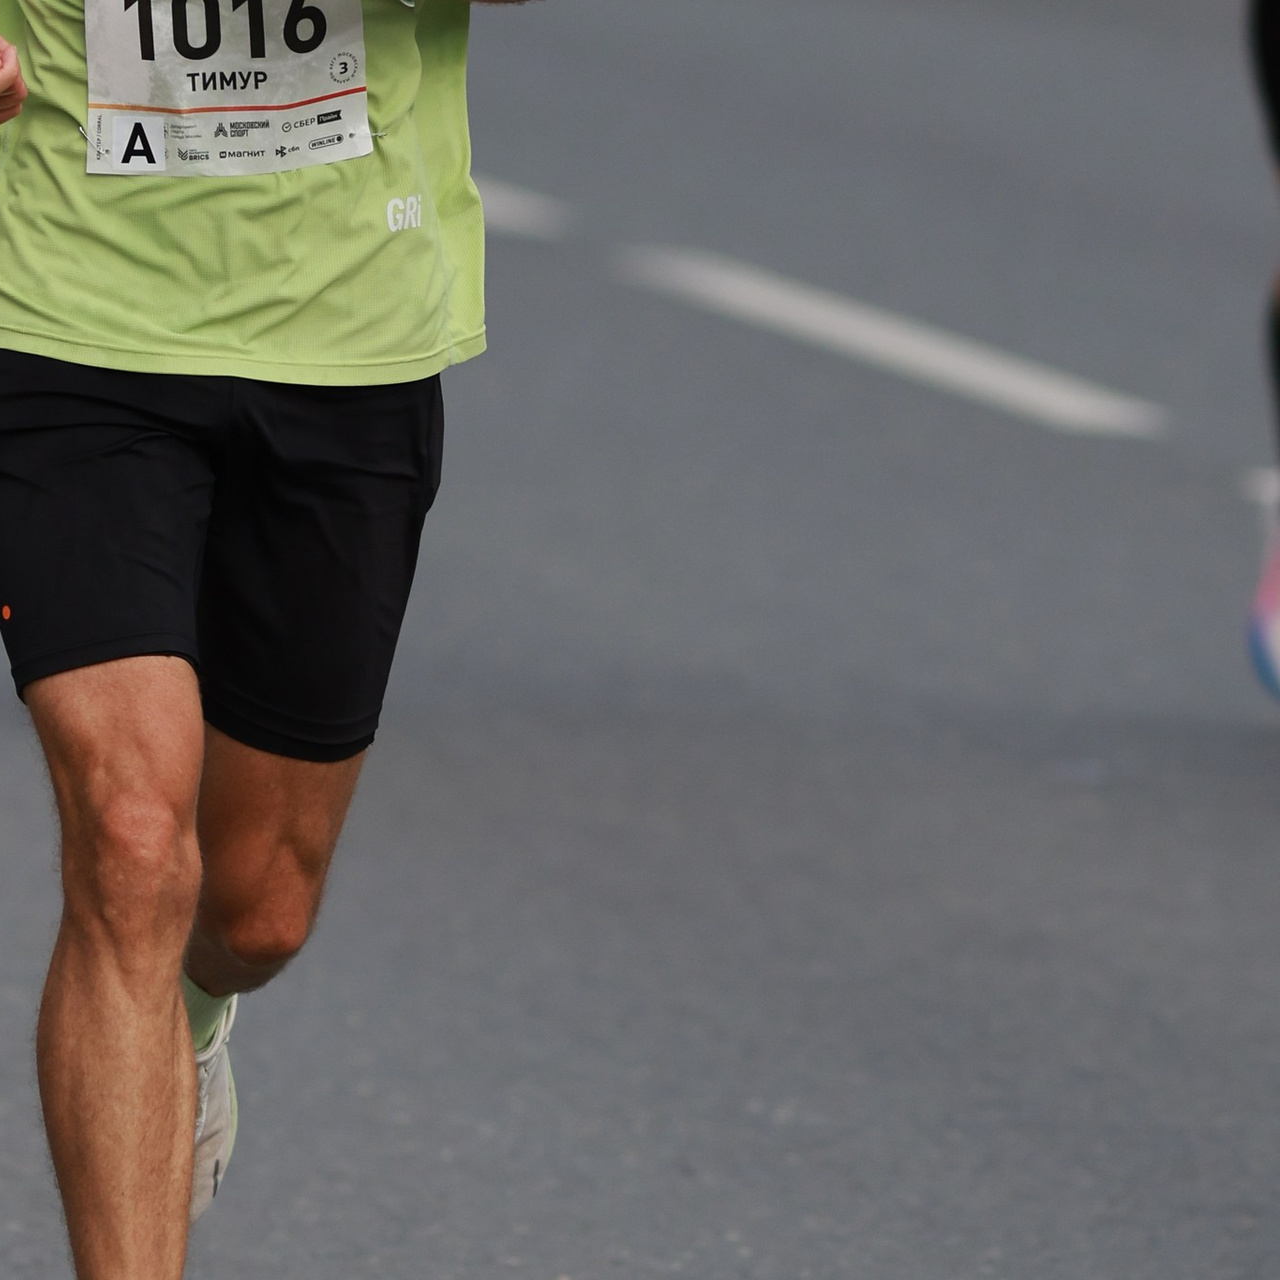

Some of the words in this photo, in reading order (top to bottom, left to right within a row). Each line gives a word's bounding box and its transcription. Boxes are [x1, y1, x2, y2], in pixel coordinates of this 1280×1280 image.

[339, 61, 348, 75] 3
[186, 71, 267, 91] ТИМУР
[230, 119, 270, 130] МОСКОВСКИЙ
[293, 117, 316, 129] СБЕР
[230, 129, 249, 138] СПОРТ
[311, 137, 336, 148] WINLINE
